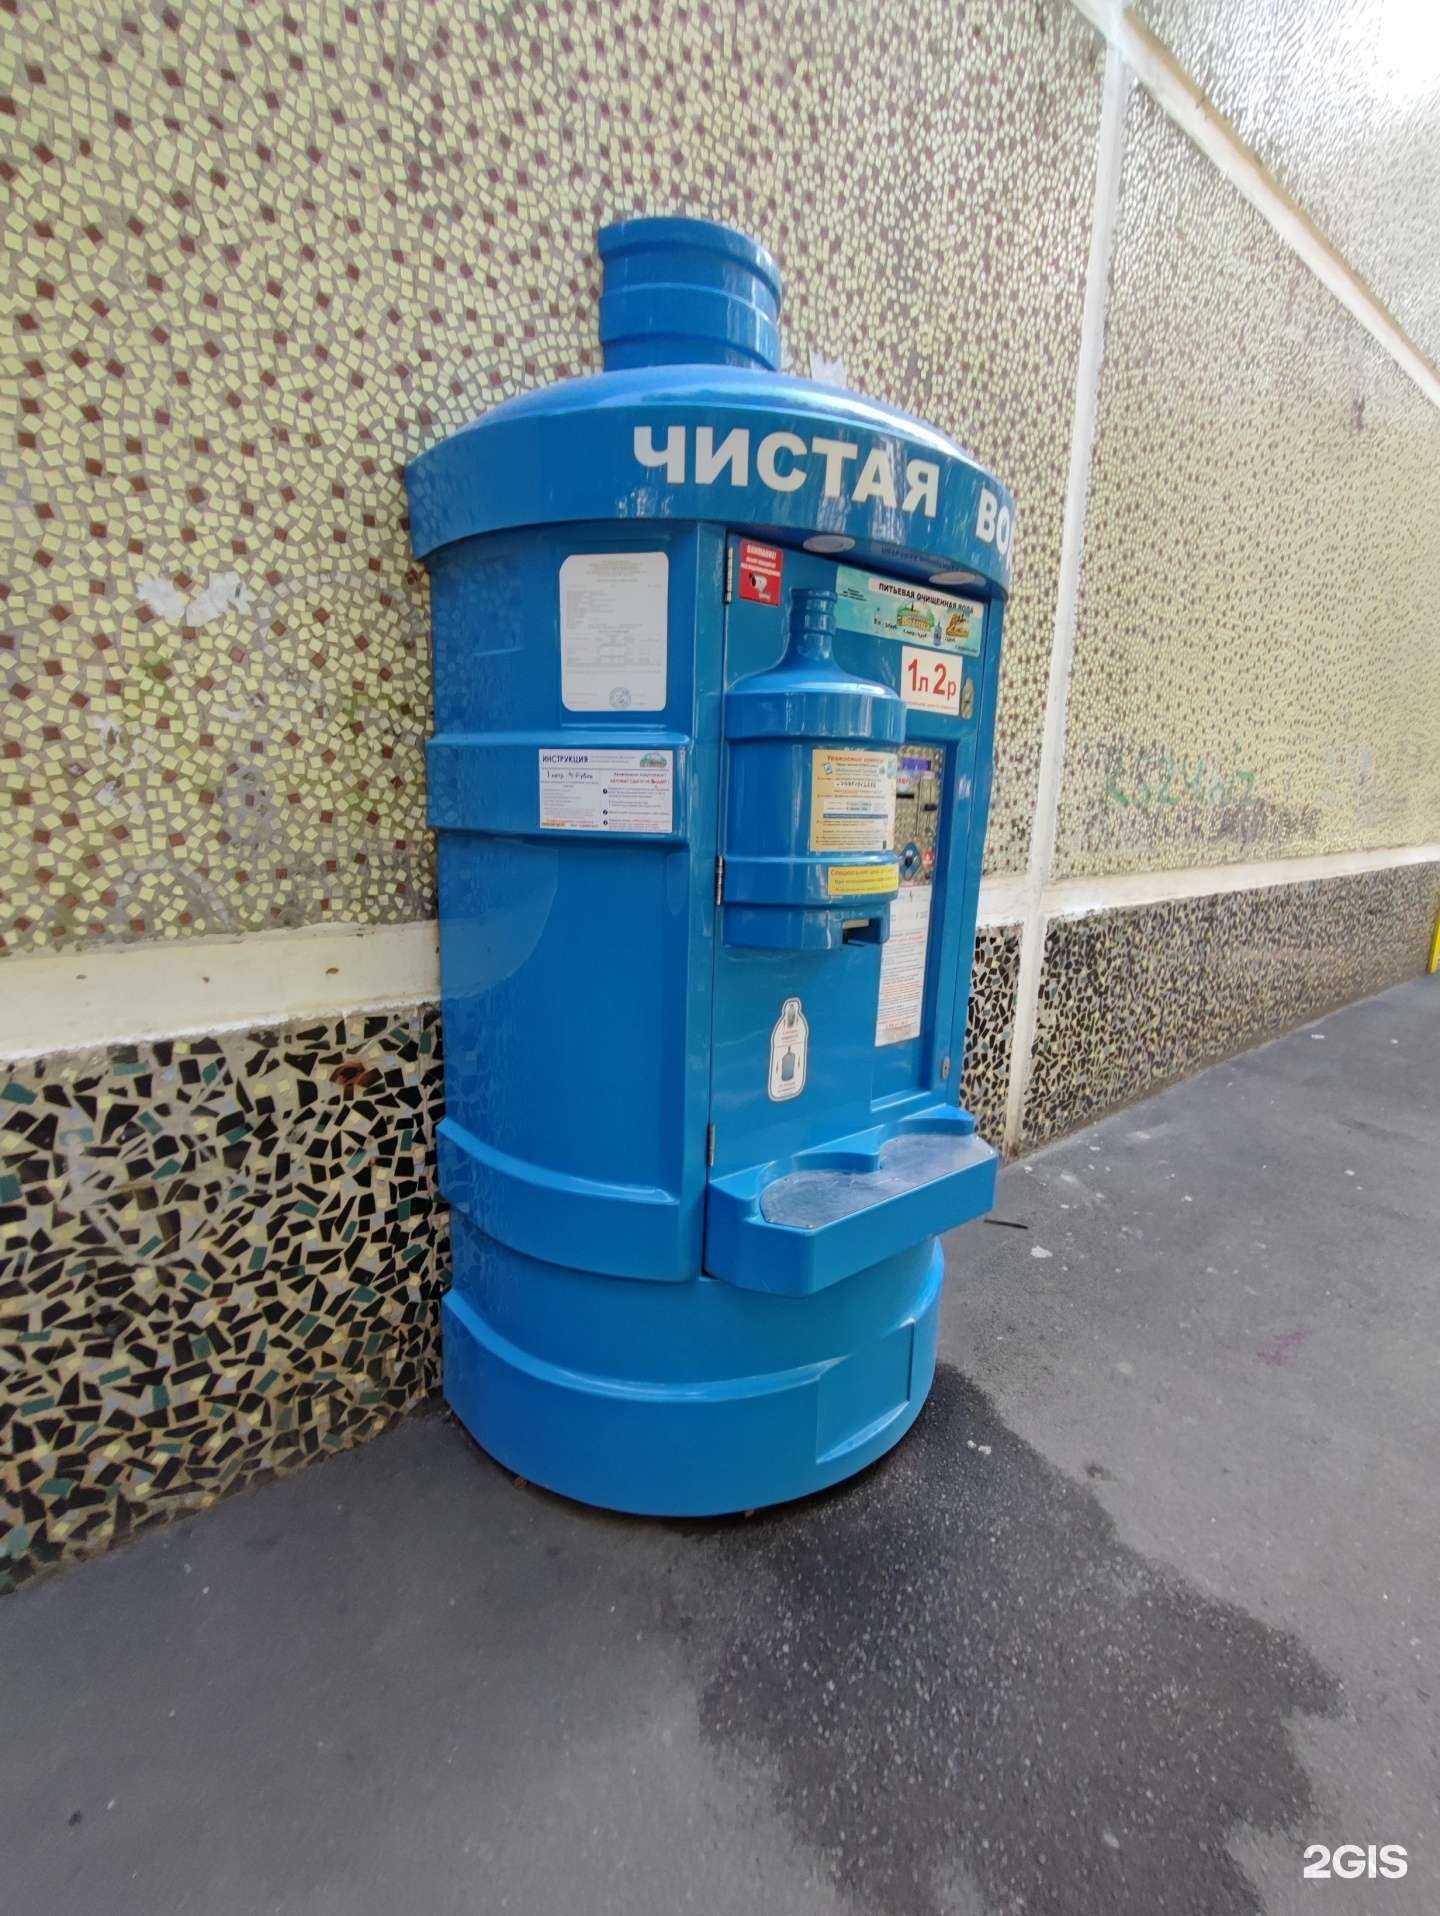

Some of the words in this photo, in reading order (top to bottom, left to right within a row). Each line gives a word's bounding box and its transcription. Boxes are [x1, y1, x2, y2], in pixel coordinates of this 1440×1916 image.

[633, 425, 940, 518] ЧИСТАЯ
[879, 582, 915, 599] ПИТЬЕВАЯ
[916, 592, 957, 609] ОЧИЩЕННАЯ
[907, 658, 928, 692] 1л
[933, 663, 957, 700] 2р
[542, 755, 589, 764] ИНСТРУКЦИЯ
